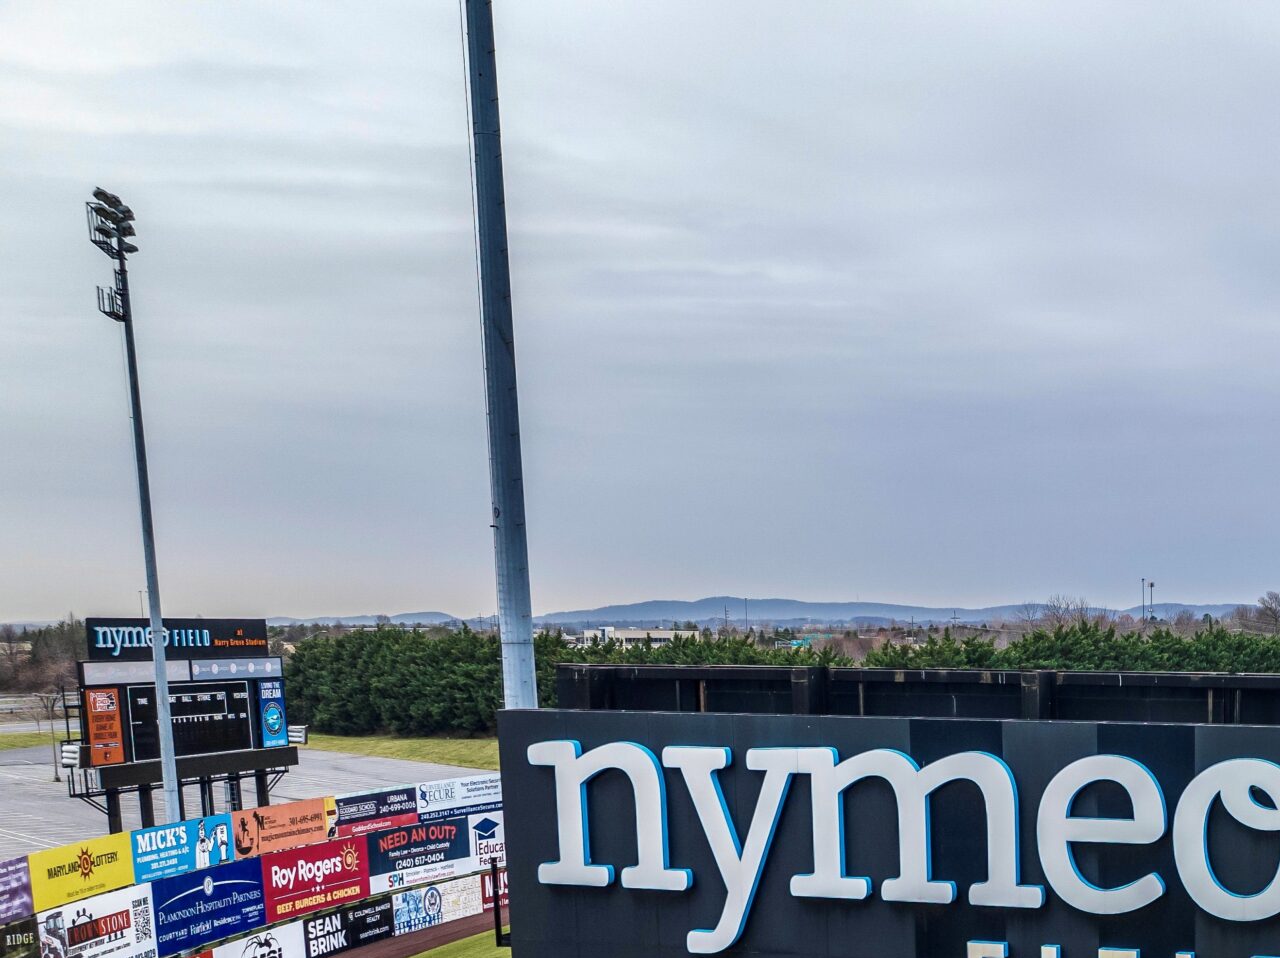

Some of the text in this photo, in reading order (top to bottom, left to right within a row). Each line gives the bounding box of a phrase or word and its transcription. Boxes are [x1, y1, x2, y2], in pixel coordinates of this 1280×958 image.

[174, 629, 210, 647] FIELD
[214, 638, 266, 647] Harry Grove Stadium
[261, 689, 281, 699] DREAM
[466, 785, 484, 793] Solutions
[387, 793, 408, 803] URBANA
[339, 803, 376, 815] GODDARD SCHOOL
[379, 801, 416, 814] 240-699-0006
[136, 825, 188, 854] MICK'S
[379, 825, 457, 853] NEED AN OUT?
[479, 841, 505, 855] Educa
[395, 853, 445, 870] (240) 617-0404
[480, 853, 504, 866] Fedal
[47, 861, 80, 880] MARYLAND
[271, 856, 342, 890] Roy Rogers
[388, 872, 404, 888] SPH
[132, 896, 149, 910] SCAN ME
[158, 889, 261, 926] PLAMONDON HOSPITALITY PARTNERS
[276, 885, 360, 915] BEEF, BURGERS & CHICKEN
[354, 902, 391, 919] COLDWELL BANKER
[307, 913, 342, 939] SEAN
[366, 914, 381, 924] REALTY
[190, 919, 212, 936] Fairfield
[359, 925, 390, 939] seanbrink.com
[6, 932, 34, 946] RIDGE
[159, 928, 188, 943] COURTYARD
[309, 929, 348, 957] BRINK
